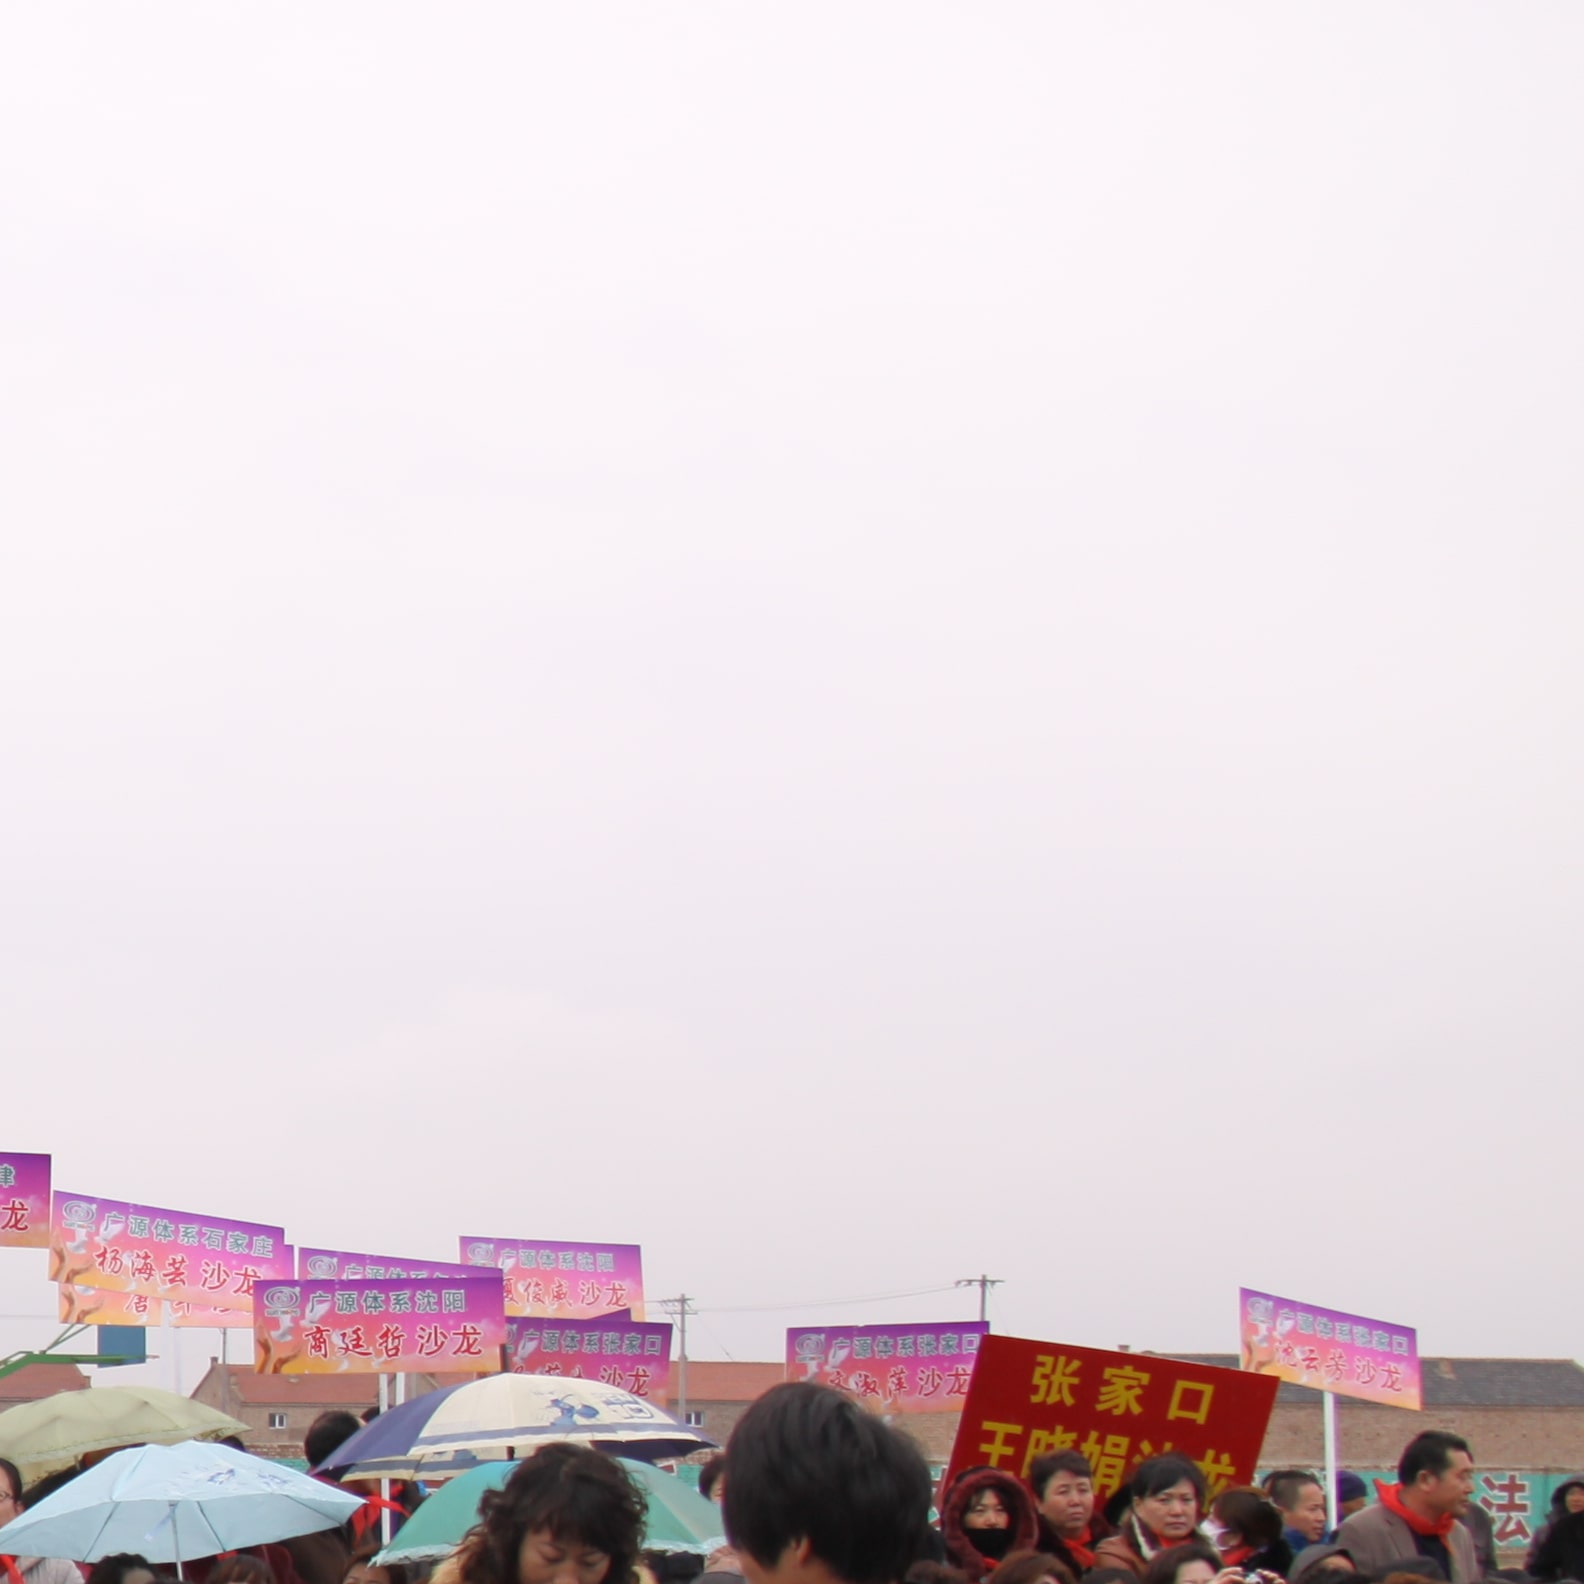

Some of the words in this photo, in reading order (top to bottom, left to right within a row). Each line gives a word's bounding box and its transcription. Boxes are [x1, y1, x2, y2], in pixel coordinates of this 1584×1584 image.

[103, 1212, 274, 1258] 广源体系石家庄
[500, 1248, 615, 1273] 广源体系沈阳
[308, 1290, 467, 1314] 广源体系沈阳
[523, 1329, 664, 1356] 广源体系张家口
[832, 1332, 981, 1360] 广源体系张家口
[1029, 1354, 1215, 1426] 张家口
[1478, 1471, 1532, 1546] 法
